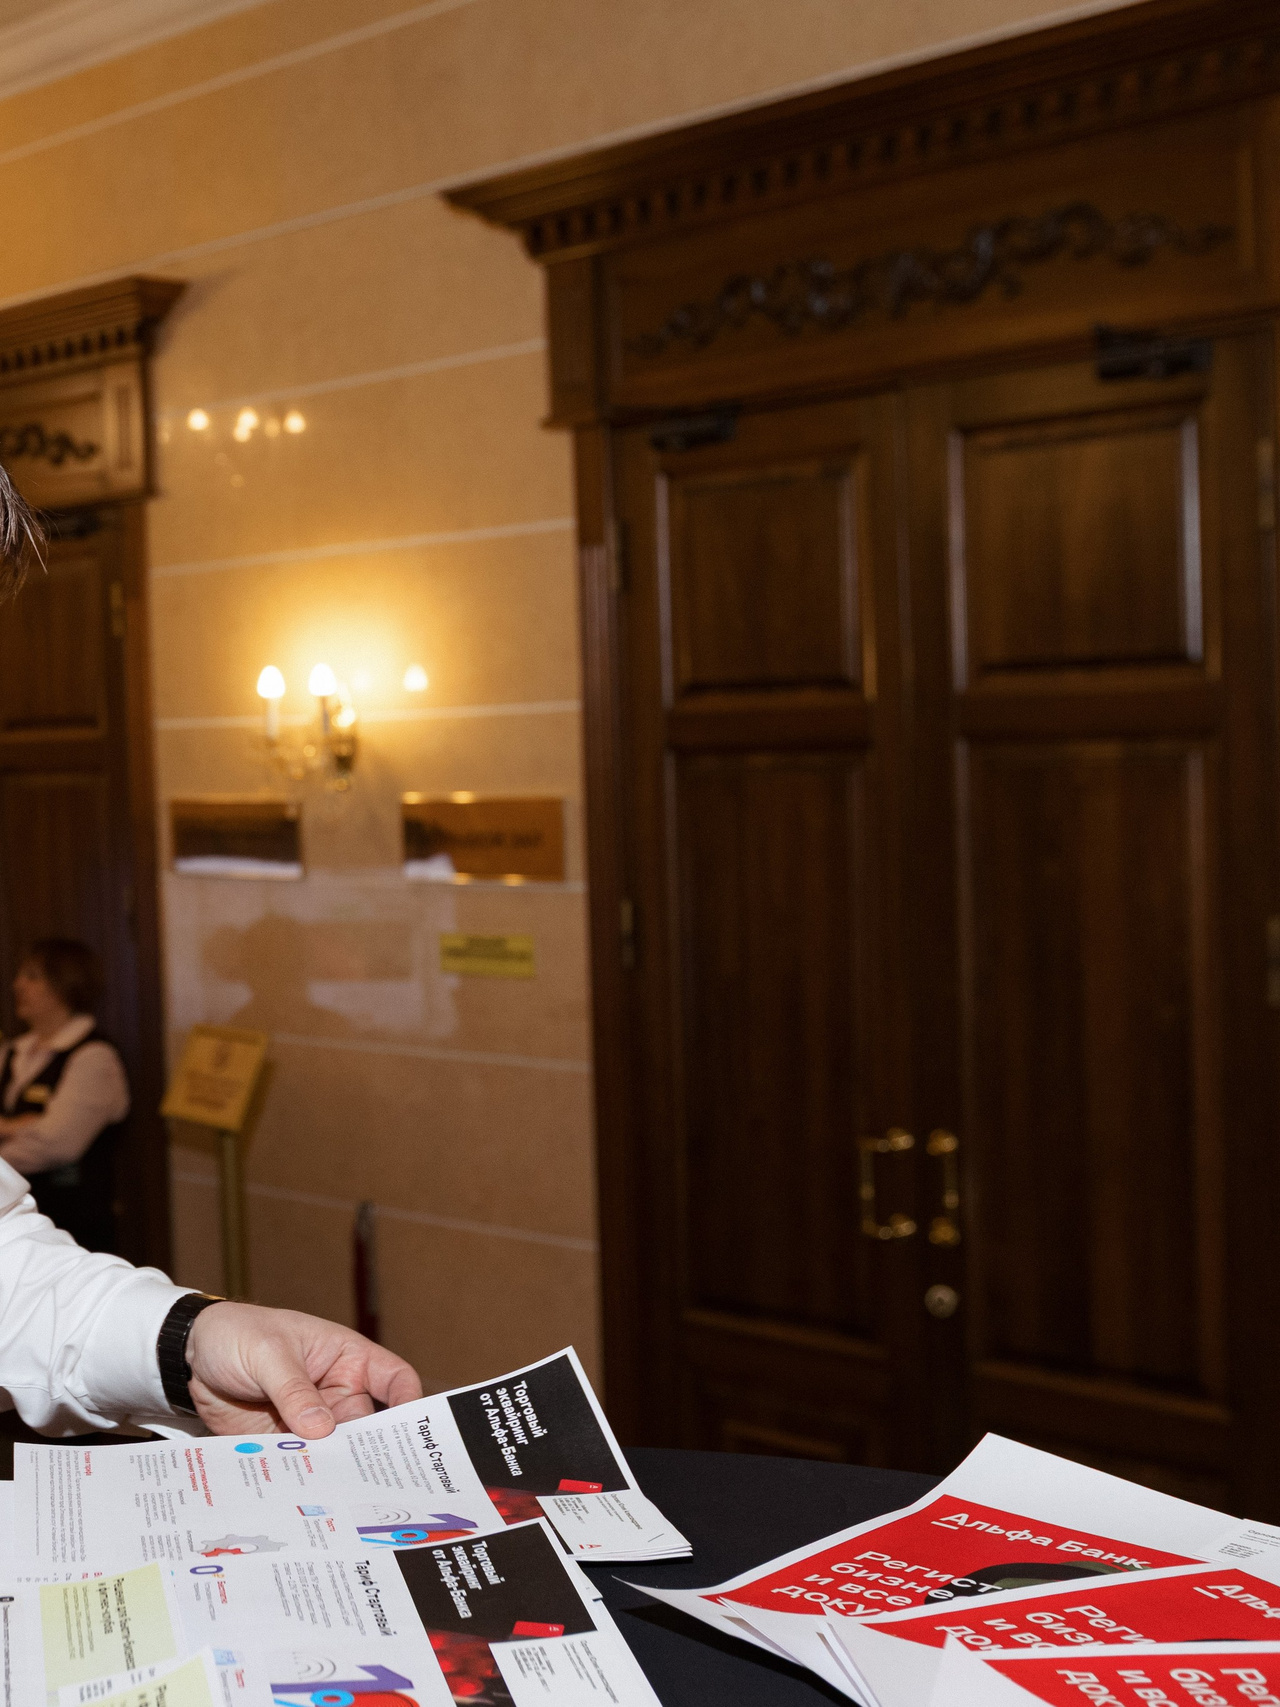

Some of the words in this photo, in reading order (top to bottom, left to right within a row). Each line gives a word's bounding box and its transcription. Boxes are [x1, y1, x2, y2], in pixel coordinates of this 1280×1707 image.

[479, 1393, 493, 1406] от
[496, 1387, 529, 1445] эквайринг
[513, 1380, 548, 1438] Торговый
[417, 1415, 440, 1450] Тариф
[429, 1451, 460, 1494] Стартовый
[485, 1408, 523, 1476] Альфа-Банка
[302, 1455, 314, 1474] Бесплатно
[325, 1518, 336, 1532] Просто
[931, 1513, 1053, 1546] Альфа
[1056, 1540, 1152, 1570] Банк
[354, 1560, 378, 1586] Тариф
[432, 1549, 447, 1559] от
[451, 1545, 482, 1590] эквайринг
[472, 1540, 506, 1585] Торговый
[853, 1551, 1005, 1593] Регист
[436, 1560, 472, 1619] Альфа-Банка
[770, 1585, 882, 1616] доку
[803, 1573, 835, 1586] и
[837, 1582, 913, 1606] все
[830, 1562, 958, 1600] бизне
[364, 1588, 397, 1636] Стартовый
[982, 1618, 1018, 1631] и
[1115, 1669, 1152, 1684] и
[1170, 1668, 1230, 1707] биз
